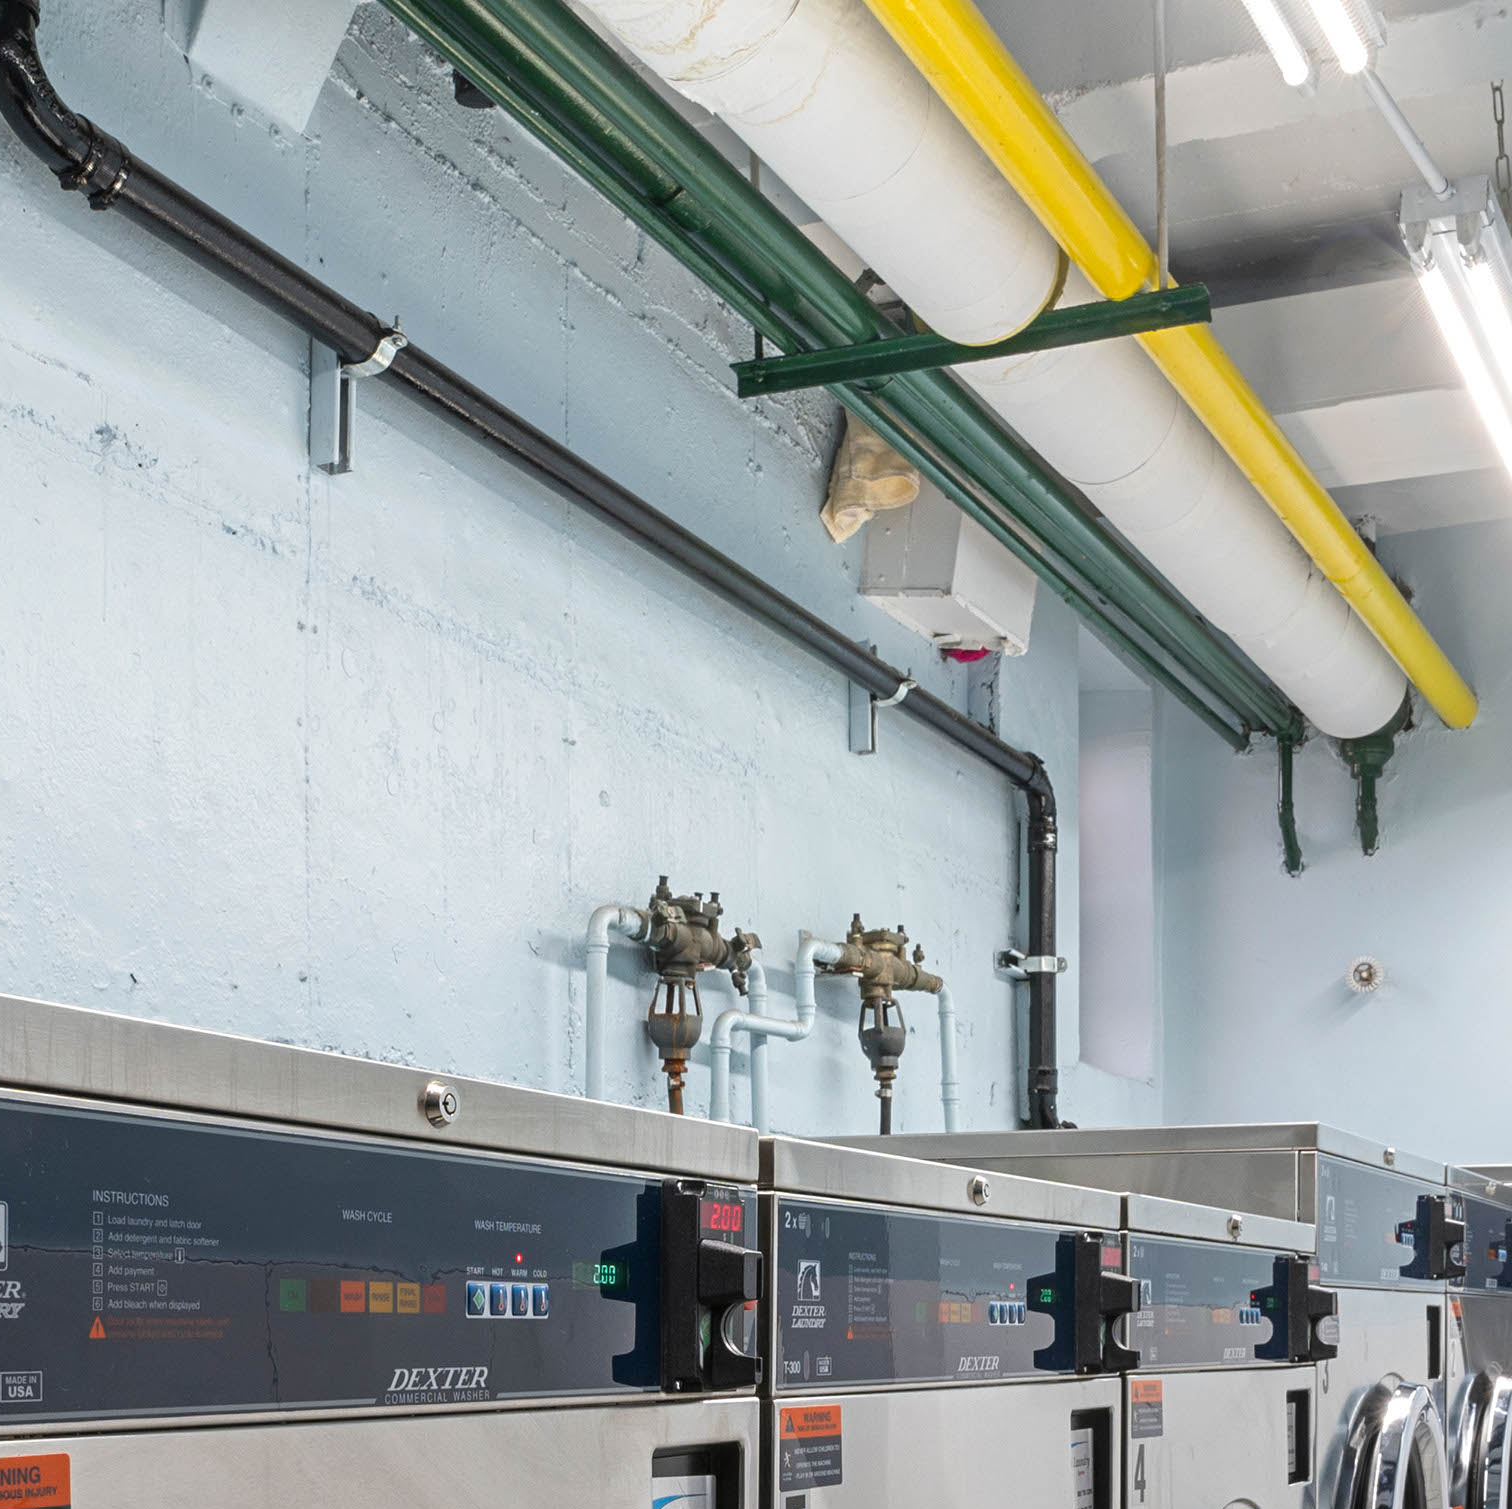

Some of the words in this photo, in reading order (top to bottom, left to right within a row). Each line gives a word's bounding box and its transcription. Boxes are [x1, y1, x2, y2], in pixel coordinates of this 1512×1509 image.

[92, 1189, 170, 1207] INSTRUCTIONS
[108, 1215, 127, 1225] Load
[128, 1216, 154, 1229] laundry
[155, 1219, 169, 1228] and
[169, 1219, 186, 1229] latch
[187, 1220, 202, 1230] door
[342, 1209, 366, 1221] WASH
[367, 1210, 393, 1223] CYCLE
[710, 1202, 742, 1231] 2.00
[475, 1219, 495, 1231] WASH
[496, 1221, 542, 1234] TEMPERATURE
[108, 1232, 123, 1242] Add
[125, 1233, 157, 1246] detergent
[159, 1234, 172, 1244] and
[173, 1235, 192, 1245] fabric
[193, 1236, 219, 1247] softener
[108, 1248, 130, 1259] Select
[108, 1266, 123, 1275] Add
[125, 1266, 155, 1278] payment
[466, 1266, 485, 1275] START
[492, 1267, 503, 1276] HOT
[511, 1269, 528, 1278] WARM
[533, 1270, 547, 1278] COLD
[108, 1283, 129, 1292] Press
[130, 1283, 155, 1292] START
[108, 1300, 123, 1309] Add
[124, 1300, 148, 1310] bleach
[149, 1301, 168, 1310] when
[169, 1300, 201, 1312] displayed
[792, 1305, 825, 1317] DEXTER
[791, 1318, 826, 1328] LAUNDRY
[784, 1361, 801, 1374] T-300
[957, 1356, 1000, 1372] DEXTER
[5, 1375, 28, 1386] MADE
[29, 1374, 38, 1384] IN
[387, 1366, 489, 1392] DEXTER
[7, 1385, 34, 1399] USA
[384, 1391, 448, 1405] COMMERCIAL
[453, 1389, 490, 1401] WASHER
[1134, 1444, 1146, 1503] 4
[24, 1485, 58, 1498] INJURY
